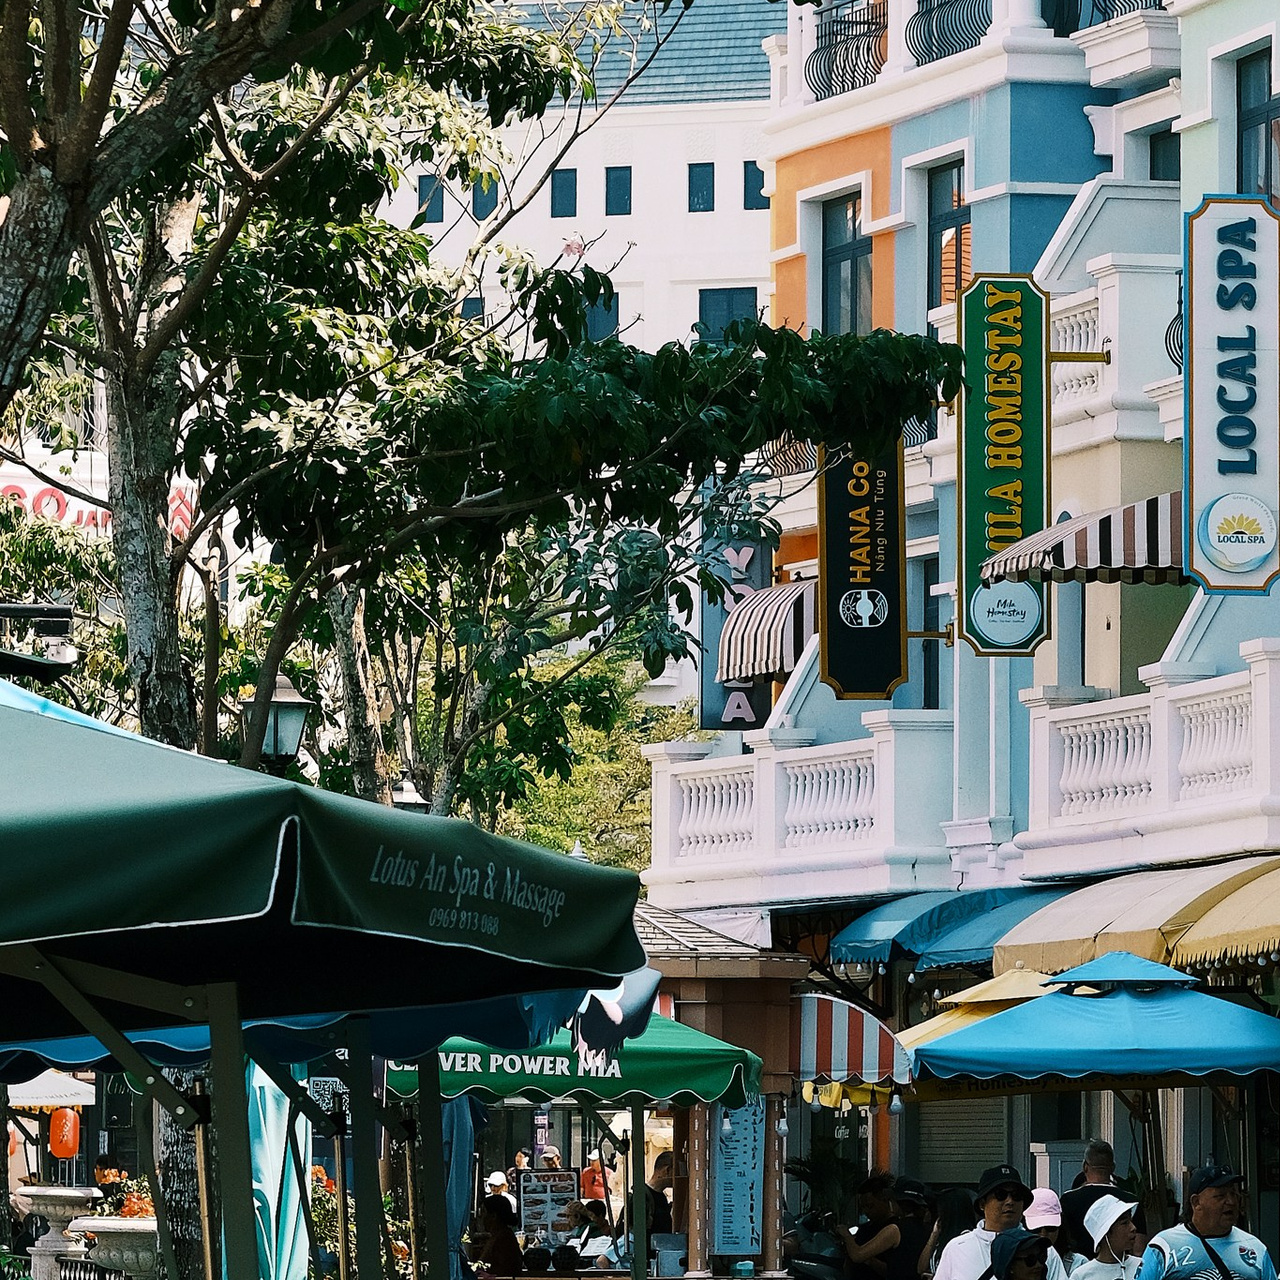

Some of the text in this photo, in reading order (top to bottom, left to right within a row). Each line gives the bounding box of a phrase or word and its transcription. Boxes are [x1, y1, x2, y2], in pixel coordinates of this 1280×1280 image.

[1216, 216, 1257, 477] LOCAL SPA
[984, 282, 1024, 470] HOMESTAY
[849, 505, 871, 584] HANA
[1217, 535, 1265, 544] LOCAL SPA
[986, 607, 1027, 620] Homestay
[370, 845, 566, 928] Lotus An Spa & Massage
[429, 907, 458, 929] 0969
[459, 910, 480, 931] 813
[489, 1053, 571, 1077] POWER
